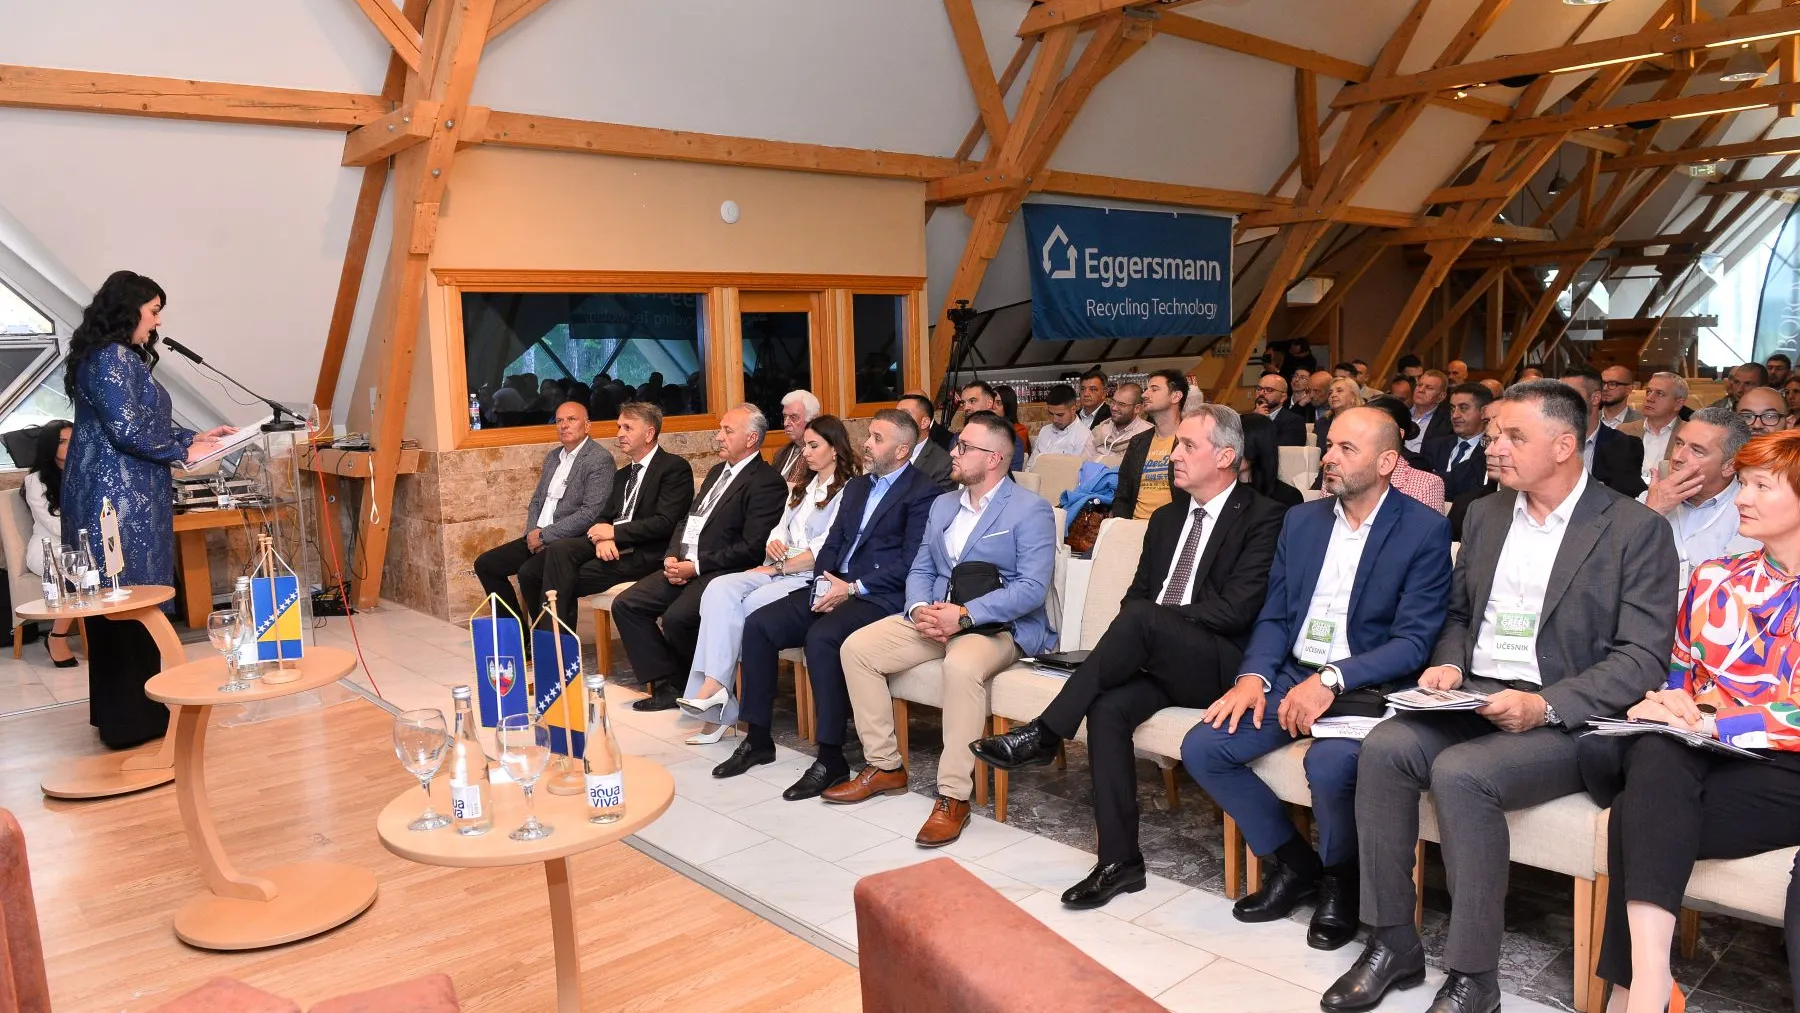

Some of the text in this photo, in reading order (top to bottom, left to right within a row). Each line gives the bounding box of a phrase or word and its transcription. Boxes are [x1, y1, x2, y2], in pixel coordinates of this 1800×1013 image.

[1084, 247, 1221, 288] Eggersmann
[1086, 297, 1149, 320] Recycling
[1304, 645, 1327, 654] UČESNIK
[1496, 642, 1529, 651] UČESNIK
[452, 799, 465, 809] ua
[592, 796, 619, 807] viva
